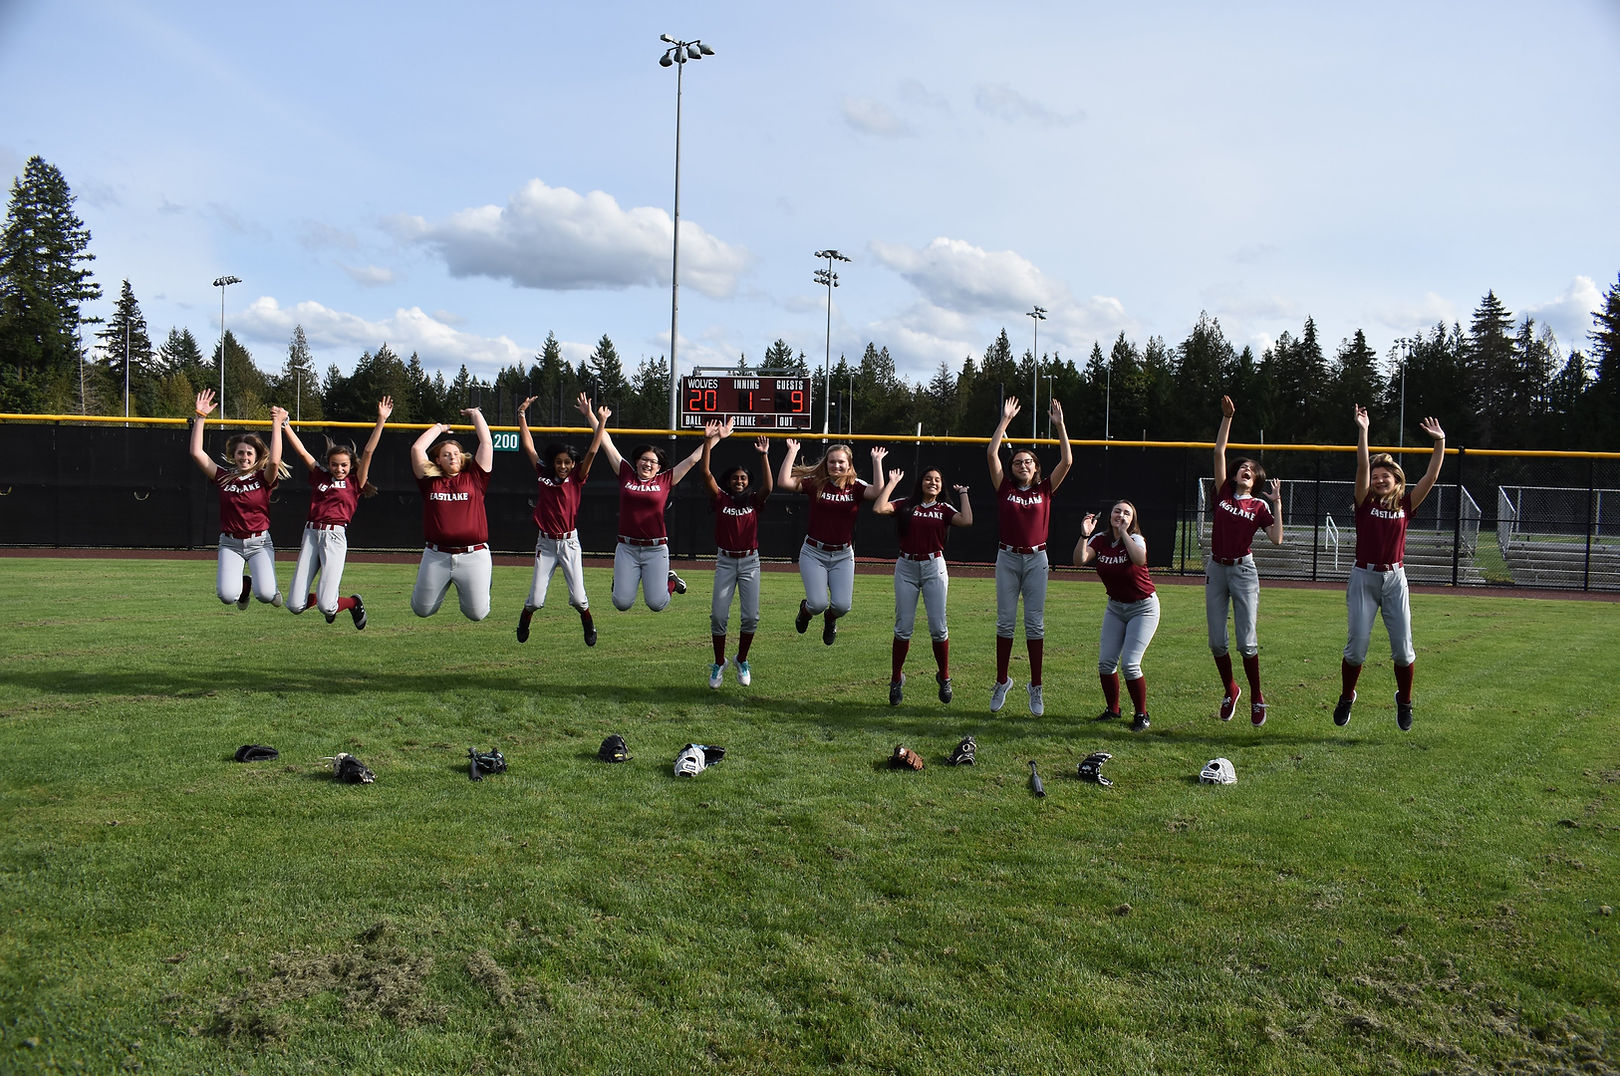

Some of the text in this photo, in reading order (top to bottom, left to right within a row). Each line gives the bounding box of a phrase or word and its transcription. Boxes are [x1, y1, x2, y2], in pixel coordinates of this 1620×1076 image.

[688, 379, 718, 389] WOLVES
[733, 380, 760, 390] INNING
[776, 380, 803, 390] GUESTS
[689, 390, 717, 411] 20
[749, 391, 753, 411] 1
[791, 391, 803, 412] 9
[685, 415, 702, 425] BALL
[732, 416, 756, 426] STRIKE
[779, 417, 793, 427] OUT
[494, 433, 518, 449] 200
[430, 492, 469, 502] EASTLAKE
[821, 492, 854, 502] ASTLAKE
[913, 510, 943, 520] STLAKE
